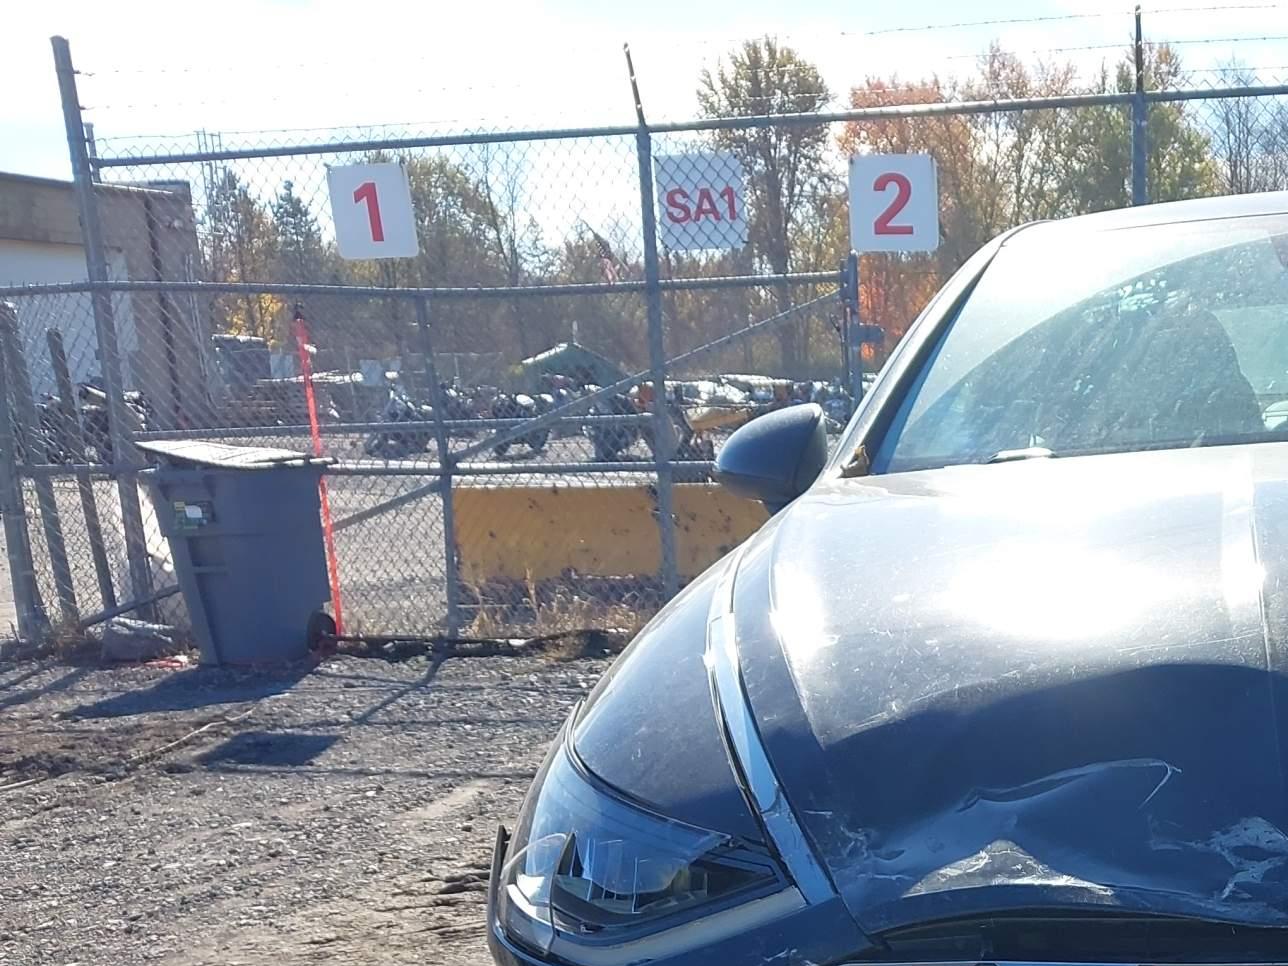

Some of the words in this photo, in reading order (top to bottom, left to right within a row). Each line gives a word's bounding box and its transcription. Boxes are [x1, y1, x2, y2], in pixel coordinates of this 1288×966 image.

[353, 181, 385, 242] 1
[666, 184, 737, 224] SA1
[873, 172, 914, 235] 2
